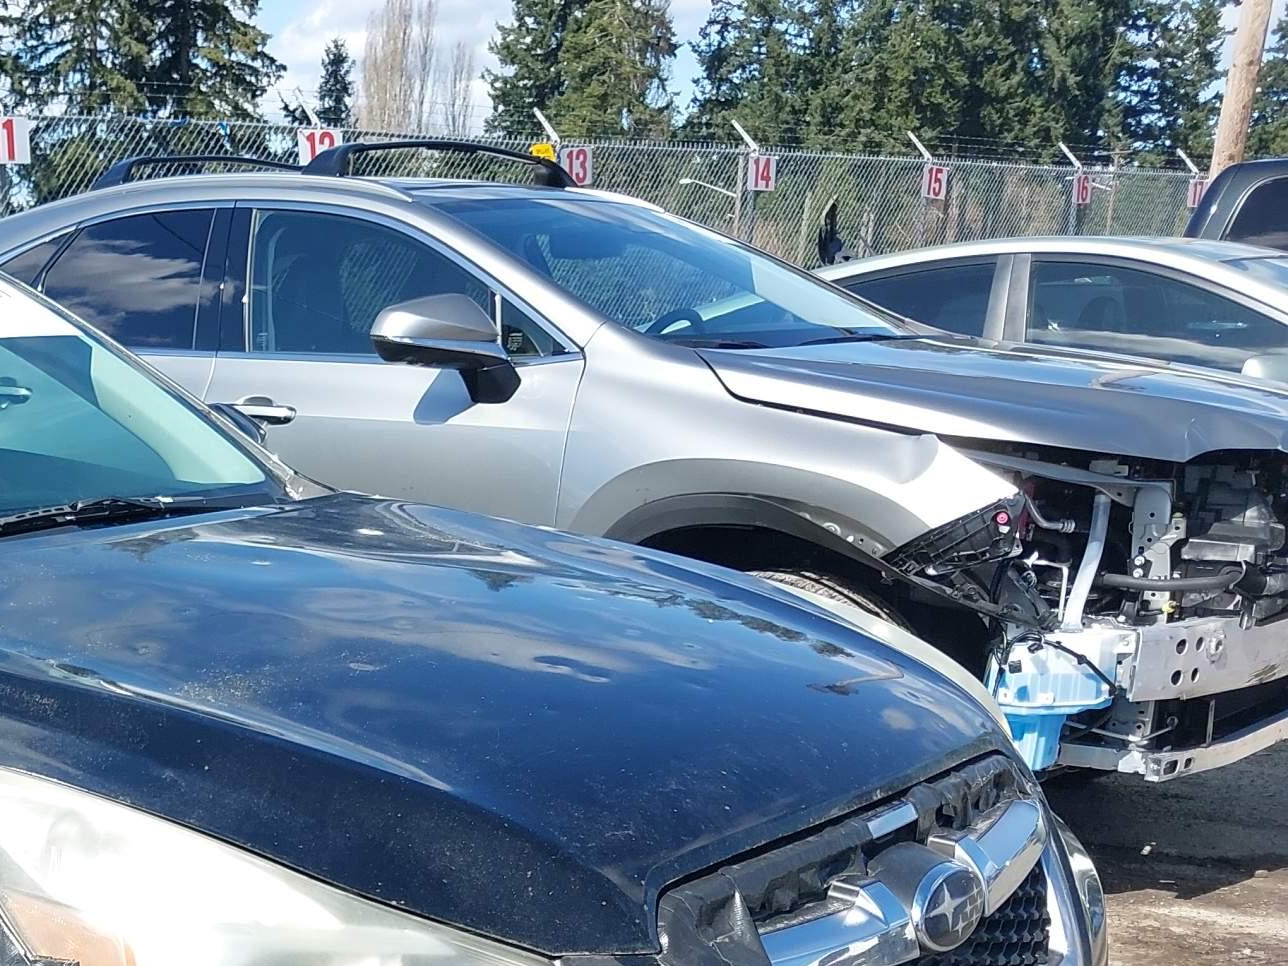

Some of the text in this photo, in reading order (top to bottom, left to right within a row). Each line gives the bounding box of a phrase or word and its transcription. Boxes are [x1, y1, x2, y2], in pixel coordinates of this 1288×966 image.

[567, 148, 588, 184] 13
[753, 157, 771, 188] 14
[926, 166, 943, 197] 15
[1076, 175, 1089, 204] 16
